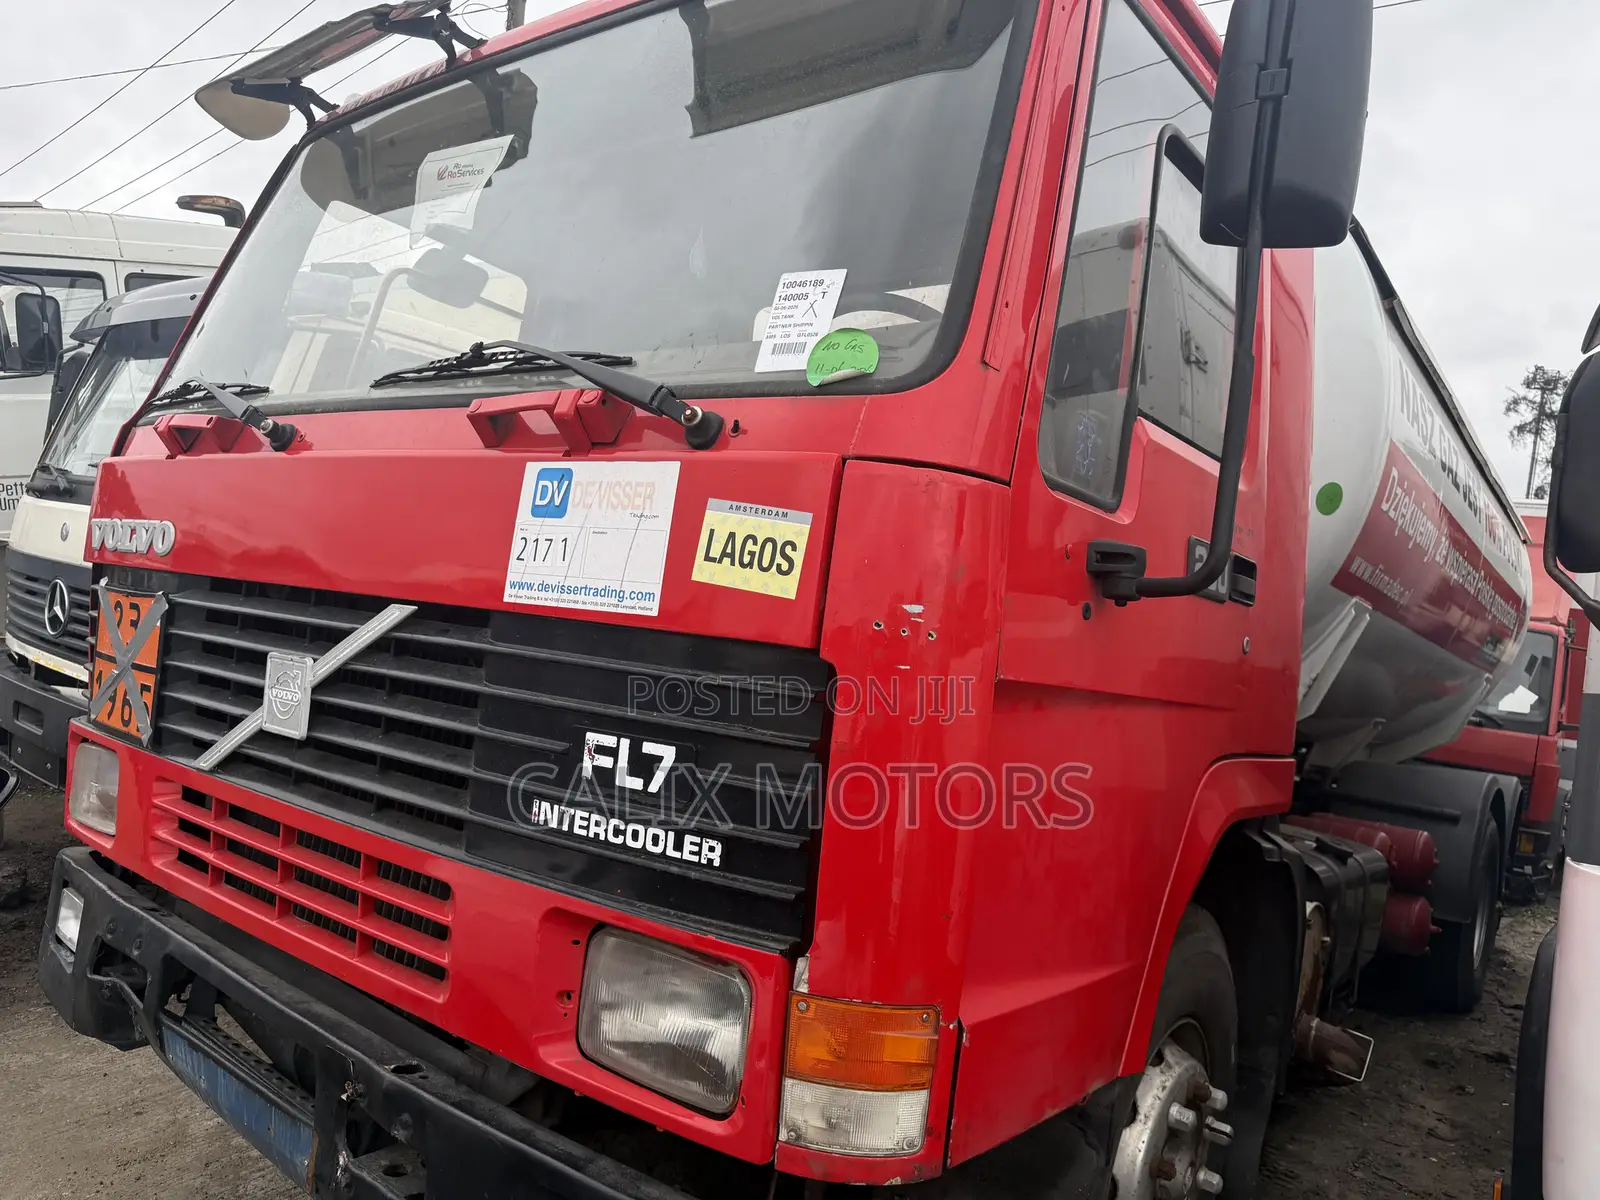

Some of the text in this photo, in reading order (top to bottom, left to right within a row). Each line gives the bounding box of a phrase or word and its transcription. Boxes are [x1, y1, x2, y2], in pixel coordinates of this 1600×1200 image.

[781, 279, 824, 290] 10046189
[778, 292, 809, 302] 140005
[822, 341, 840, 351] NO
[534, 480, 569, 506] DV
[728, 503, 789, 519] AMSTERDAM
[91, 518, 176, 557] VOLVO
[516, 536, 568, 562] 2171
[703, 528, 798, 577] LAGOS
[509, 580, 656, 603] www.devissertrading.com
[272, 688, 299, 701] VOLVO
[582, 732, 676, 793] FL7
[531, 799, 722, 866] INTERCOOLER
